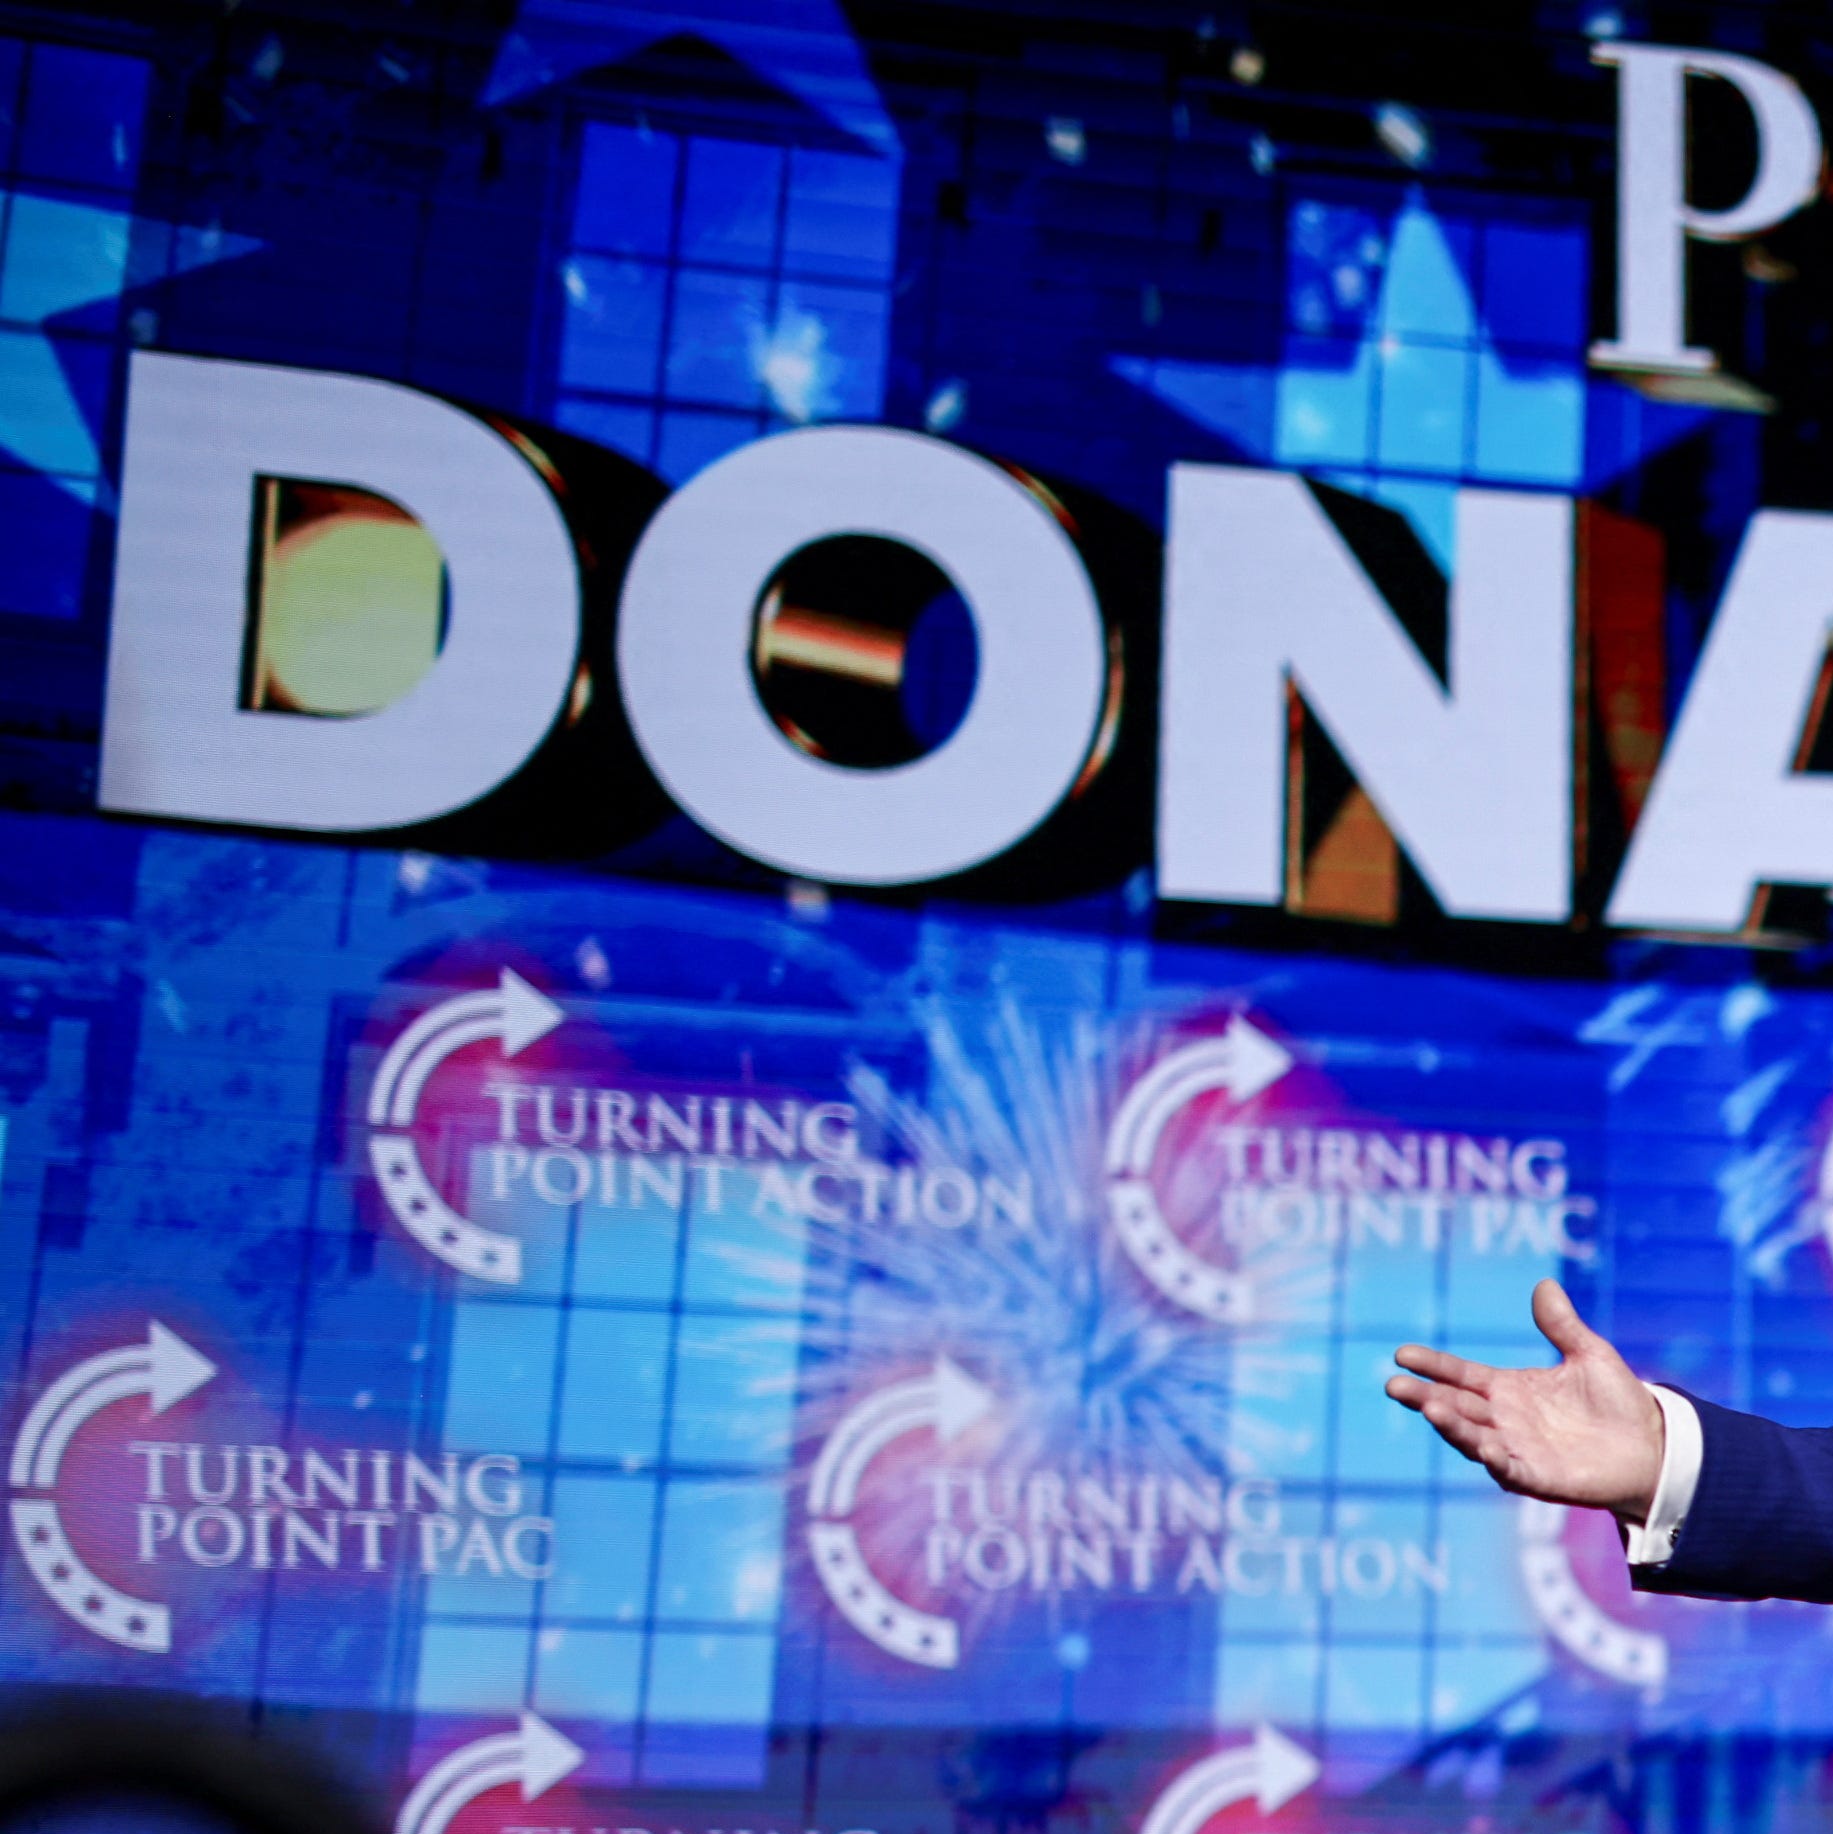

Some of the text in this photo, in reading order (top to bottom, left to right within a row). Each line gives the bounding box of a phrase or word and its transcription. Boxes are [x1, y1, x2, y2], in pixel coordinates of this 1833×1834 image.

[482, 1084, 859, 1160] TURNING
[489, 1147, 1034, 1228] POINT ACTION
[1215, 1126, 1567, 1197] TURNING
[1222, 1189, 1594, 1266] POINT PAC
[129, 1444, 522, 1512] TURNING
[926, 1469, 1280, 1534] TURNING
[136, 1507, 558, 1578] POINT PAC
[926, 1529, 1451, 1596] POINT ACTION
